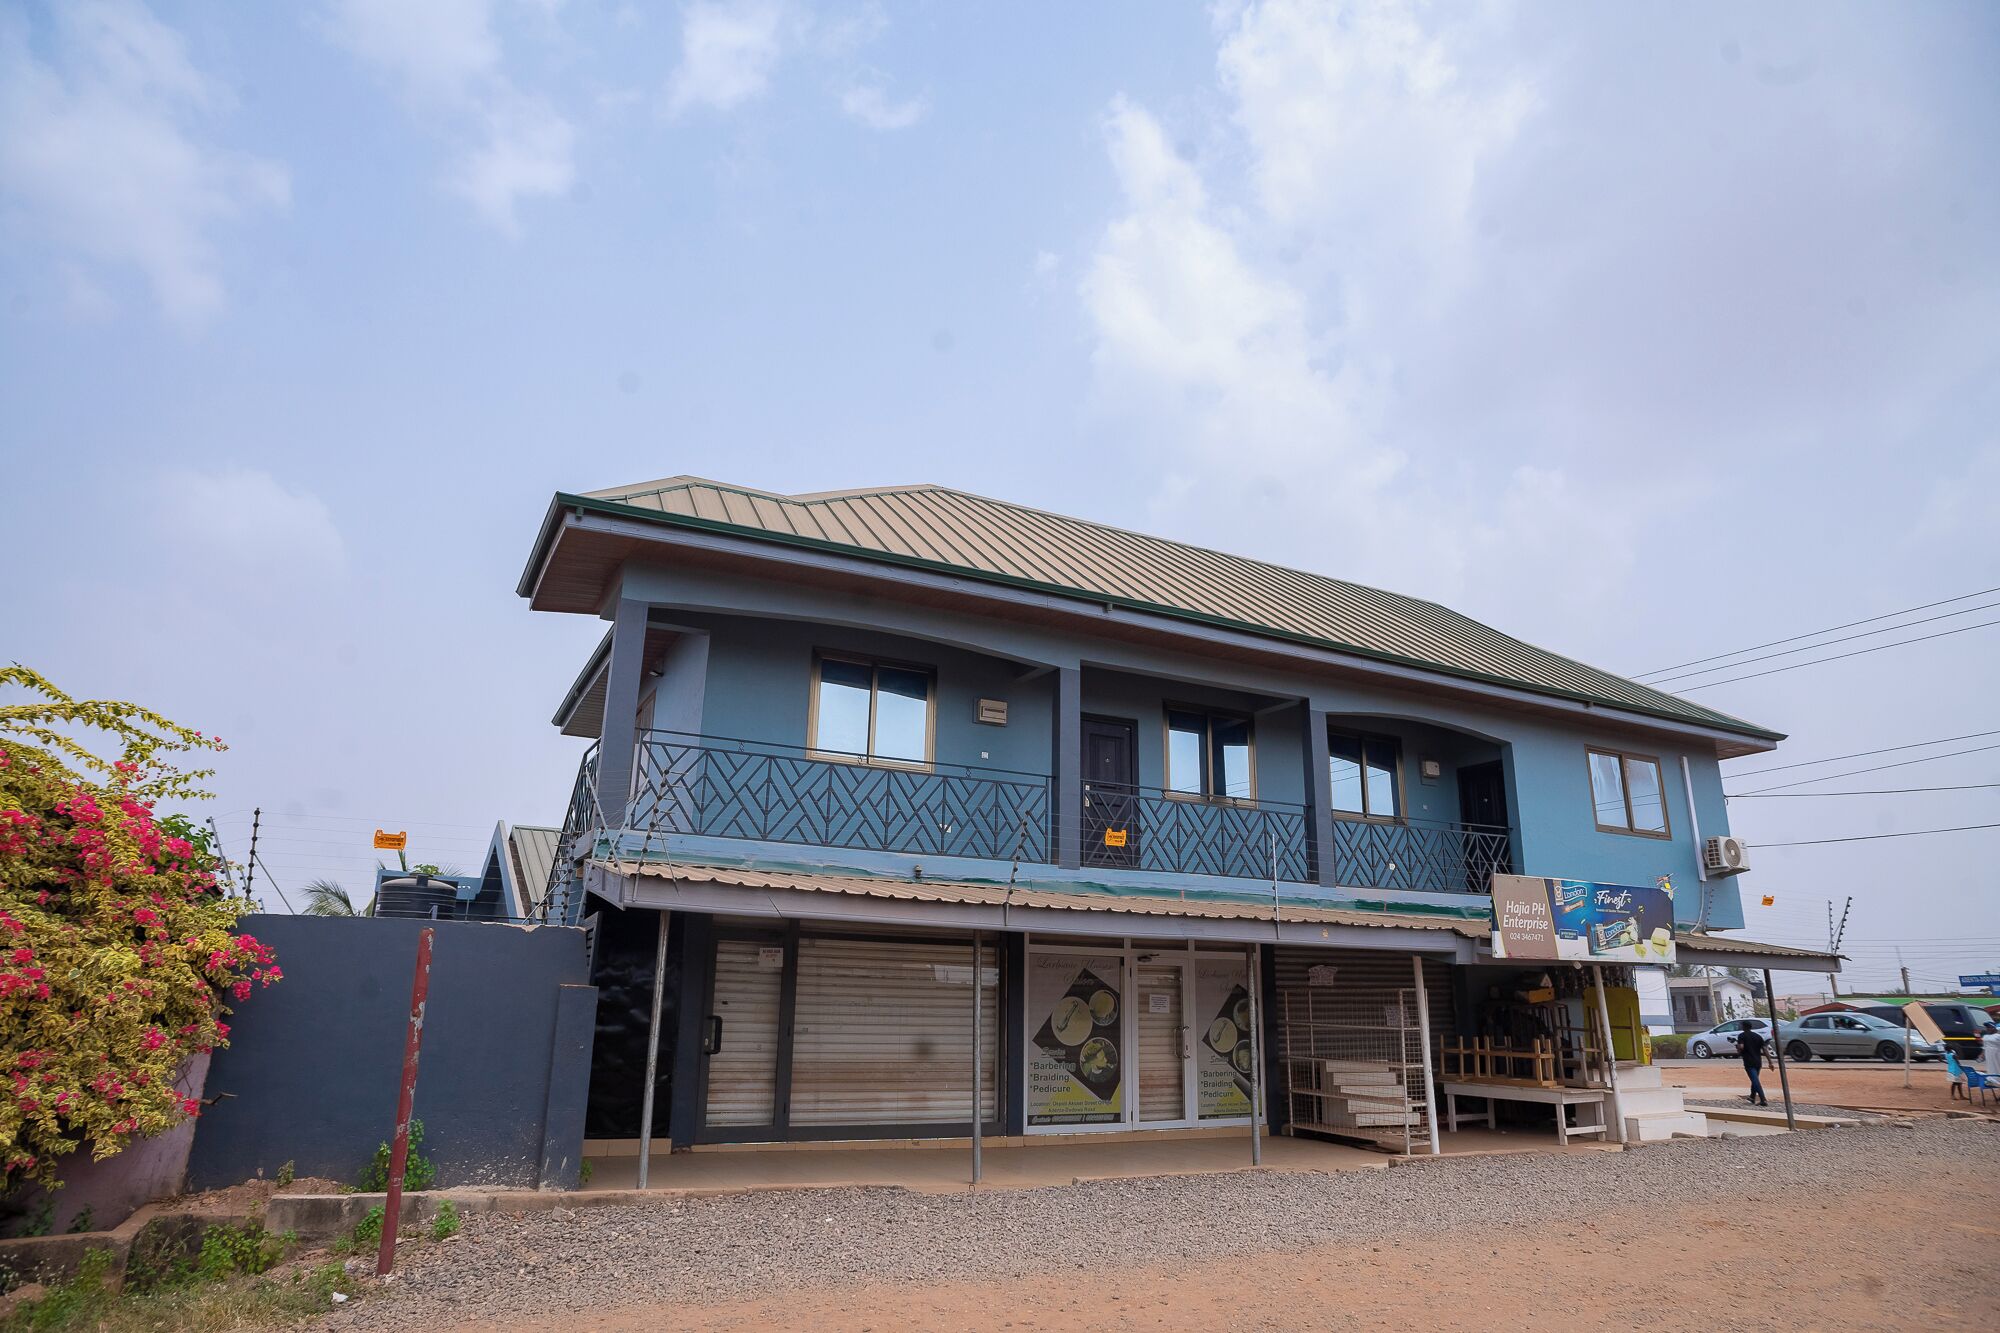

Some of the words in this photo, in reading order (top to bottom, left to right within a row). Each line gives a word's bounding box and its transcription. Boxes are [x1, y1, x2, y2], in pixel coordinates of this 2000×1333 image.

[1564, 888, 1584, 899] London
[1596, 890, 1632, 909] Finest
[1506, 900, 1530, 916] Hajia
[1532, 903, 1546, 915] PH
[1503, 915, 1549, 931] Enterprise
[1509, 932, 1521, 940] 024
